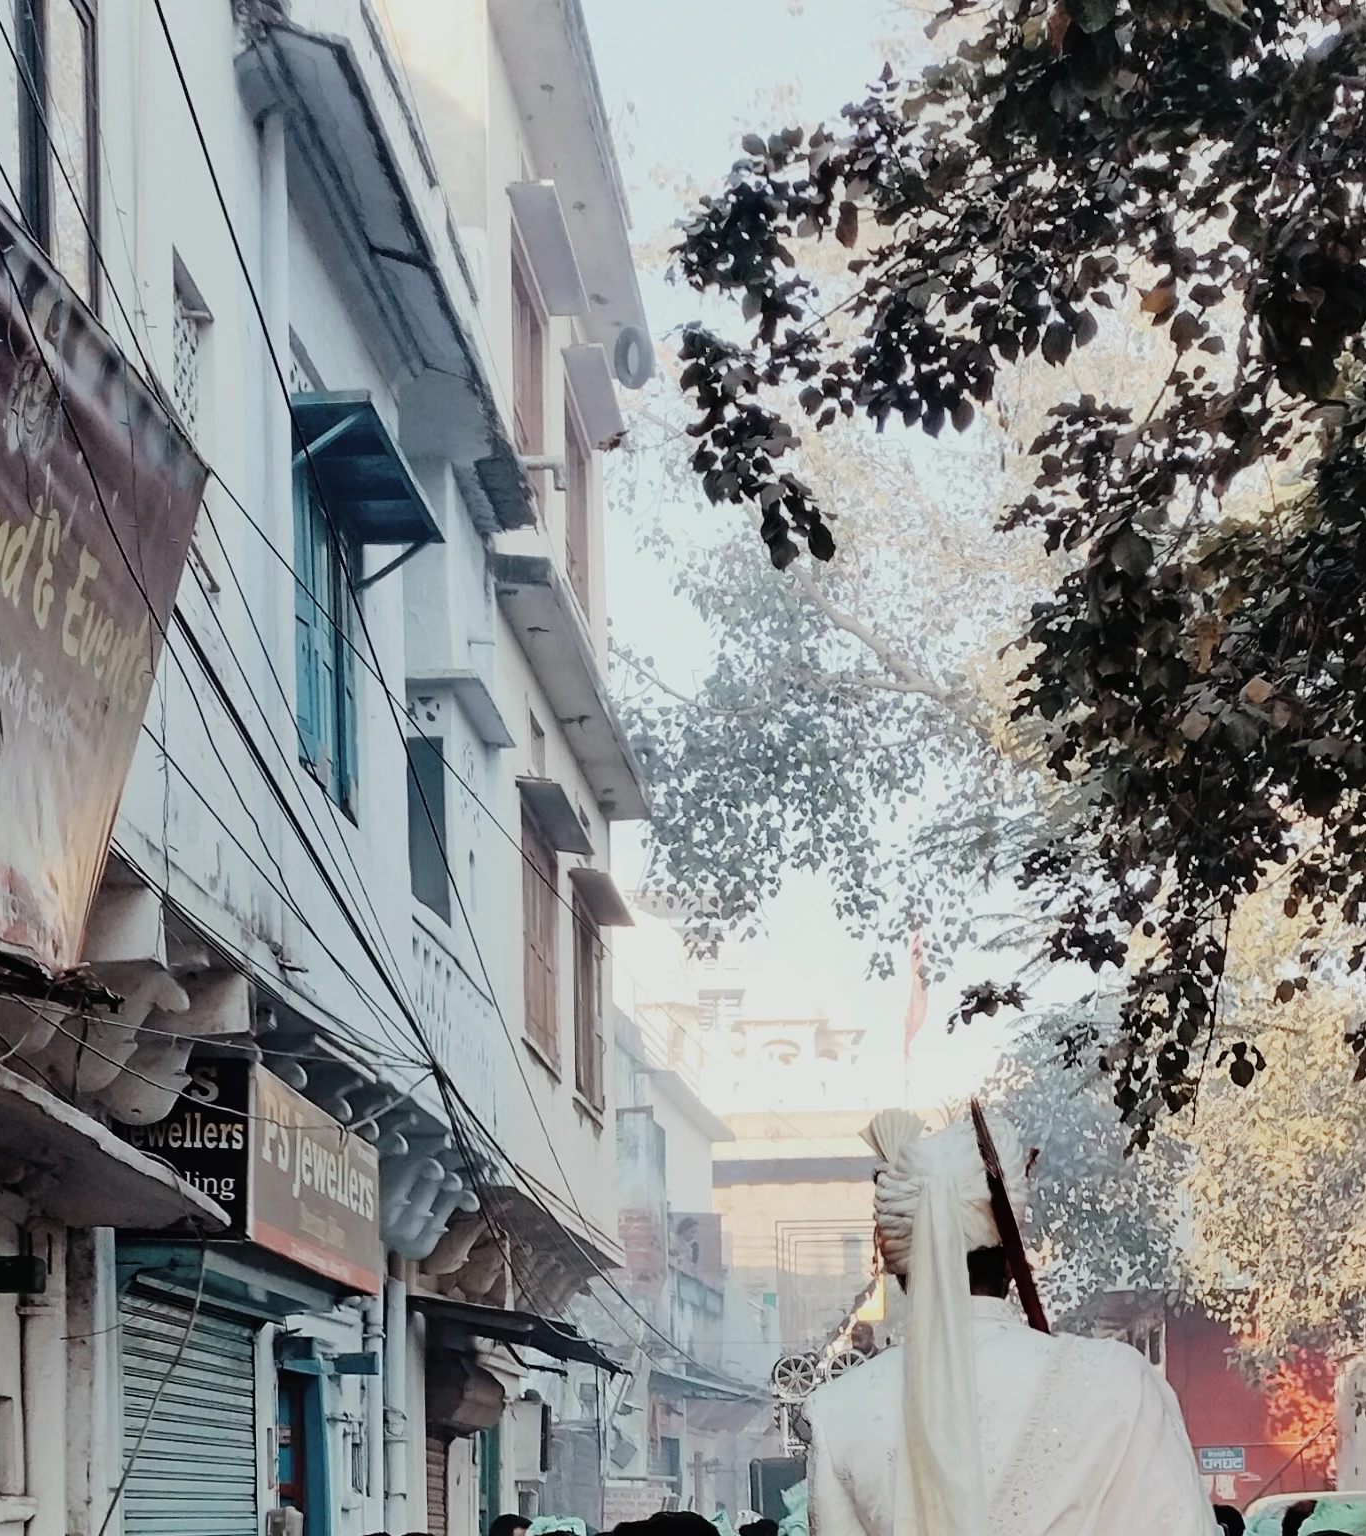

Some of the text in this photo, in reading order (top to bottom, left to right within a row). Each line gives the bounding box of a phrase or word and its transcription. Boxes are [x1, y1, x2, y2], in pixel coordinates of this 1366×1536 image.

[33, 508, 61, 630] &
[62, 544, 151, 713] Events
[125, 1112, 244, 1150] ewellers
